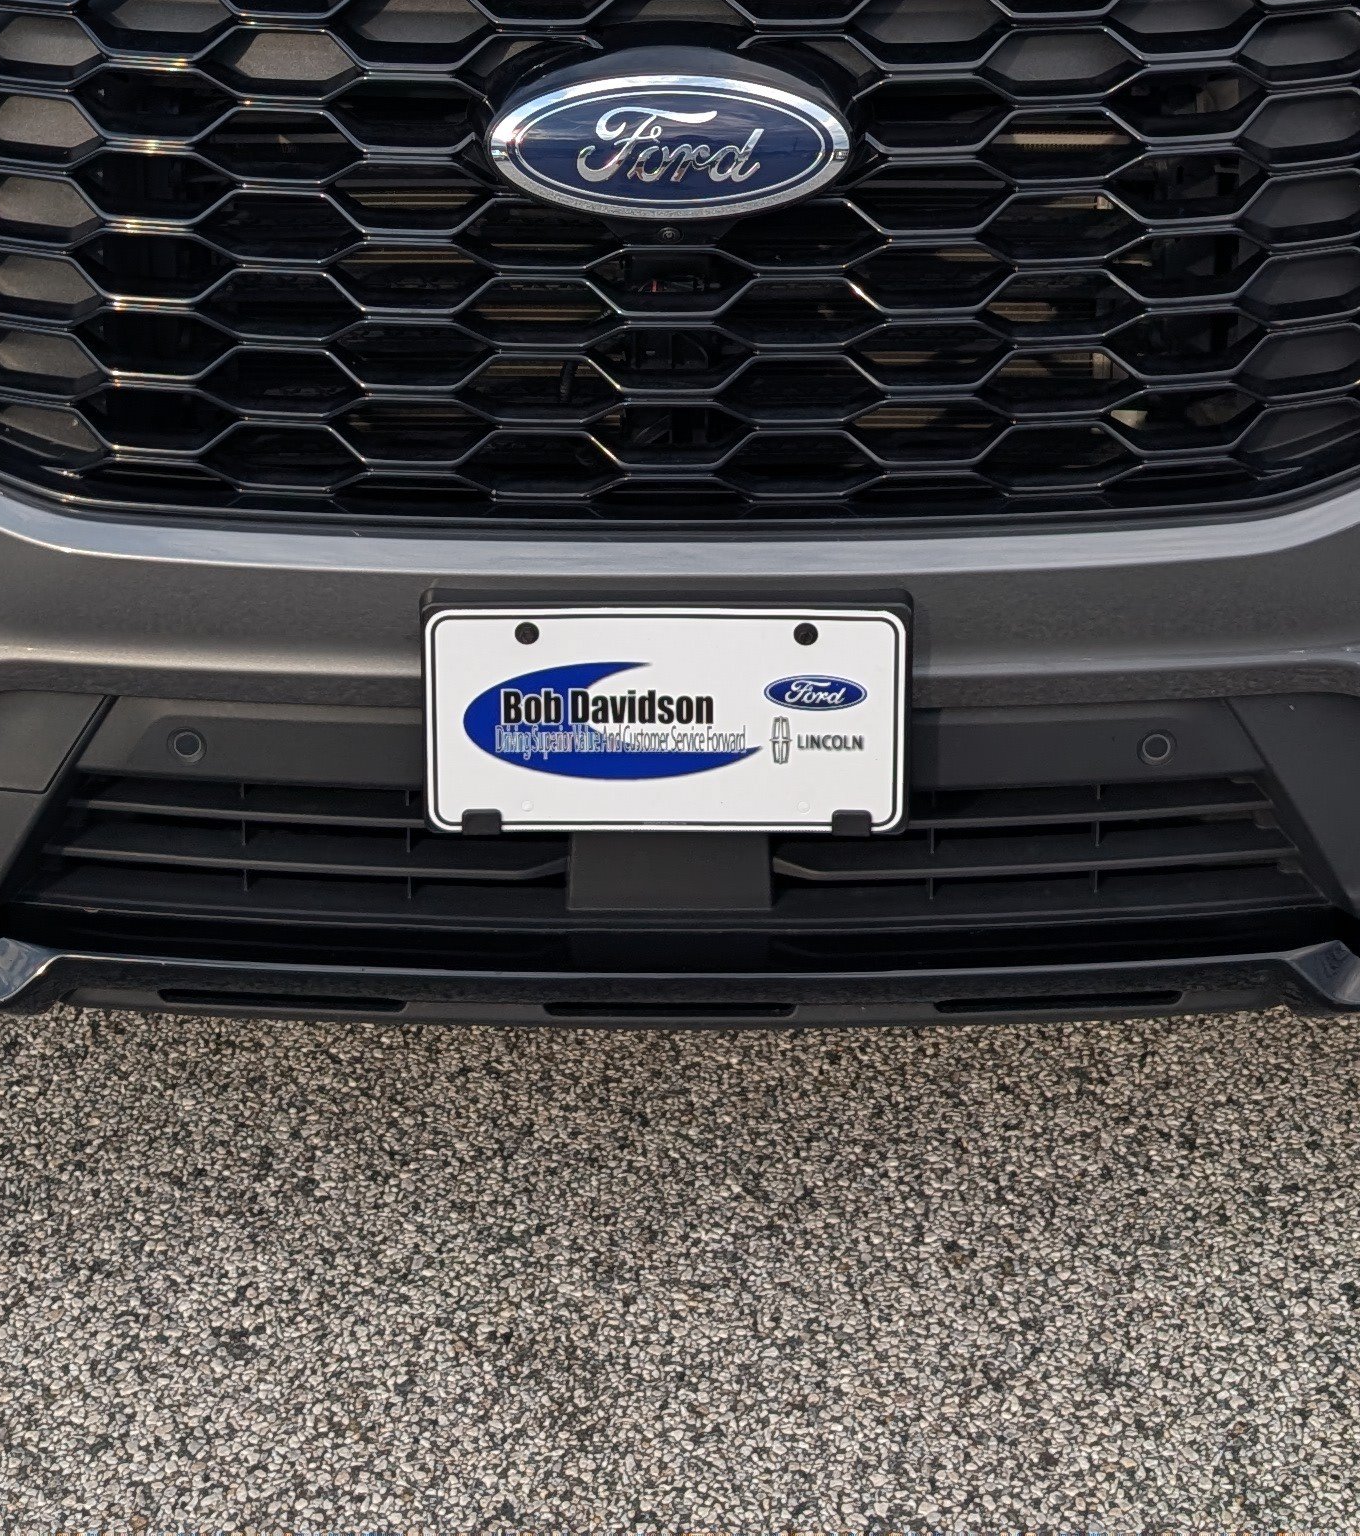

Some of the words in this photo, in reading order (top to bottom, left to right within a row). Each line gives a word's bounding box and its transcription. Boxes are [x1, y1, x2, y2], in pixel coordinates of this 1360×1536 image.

[576, 106, 765, 183] Ford
[501, 688, 564, 726] Bob
[567, 688, 715, 726] Davidson
[784, 679, 847, 705] Ford
[495, 724, 531, 760] Driving
[531, 724, 573, 760] Superior
[623, 725, 669, 753] Customer
[671, 725, 705, 753] Service
[706, 725, 746, 753] Forward
[797, 733, 864, 751] LINCOLN
